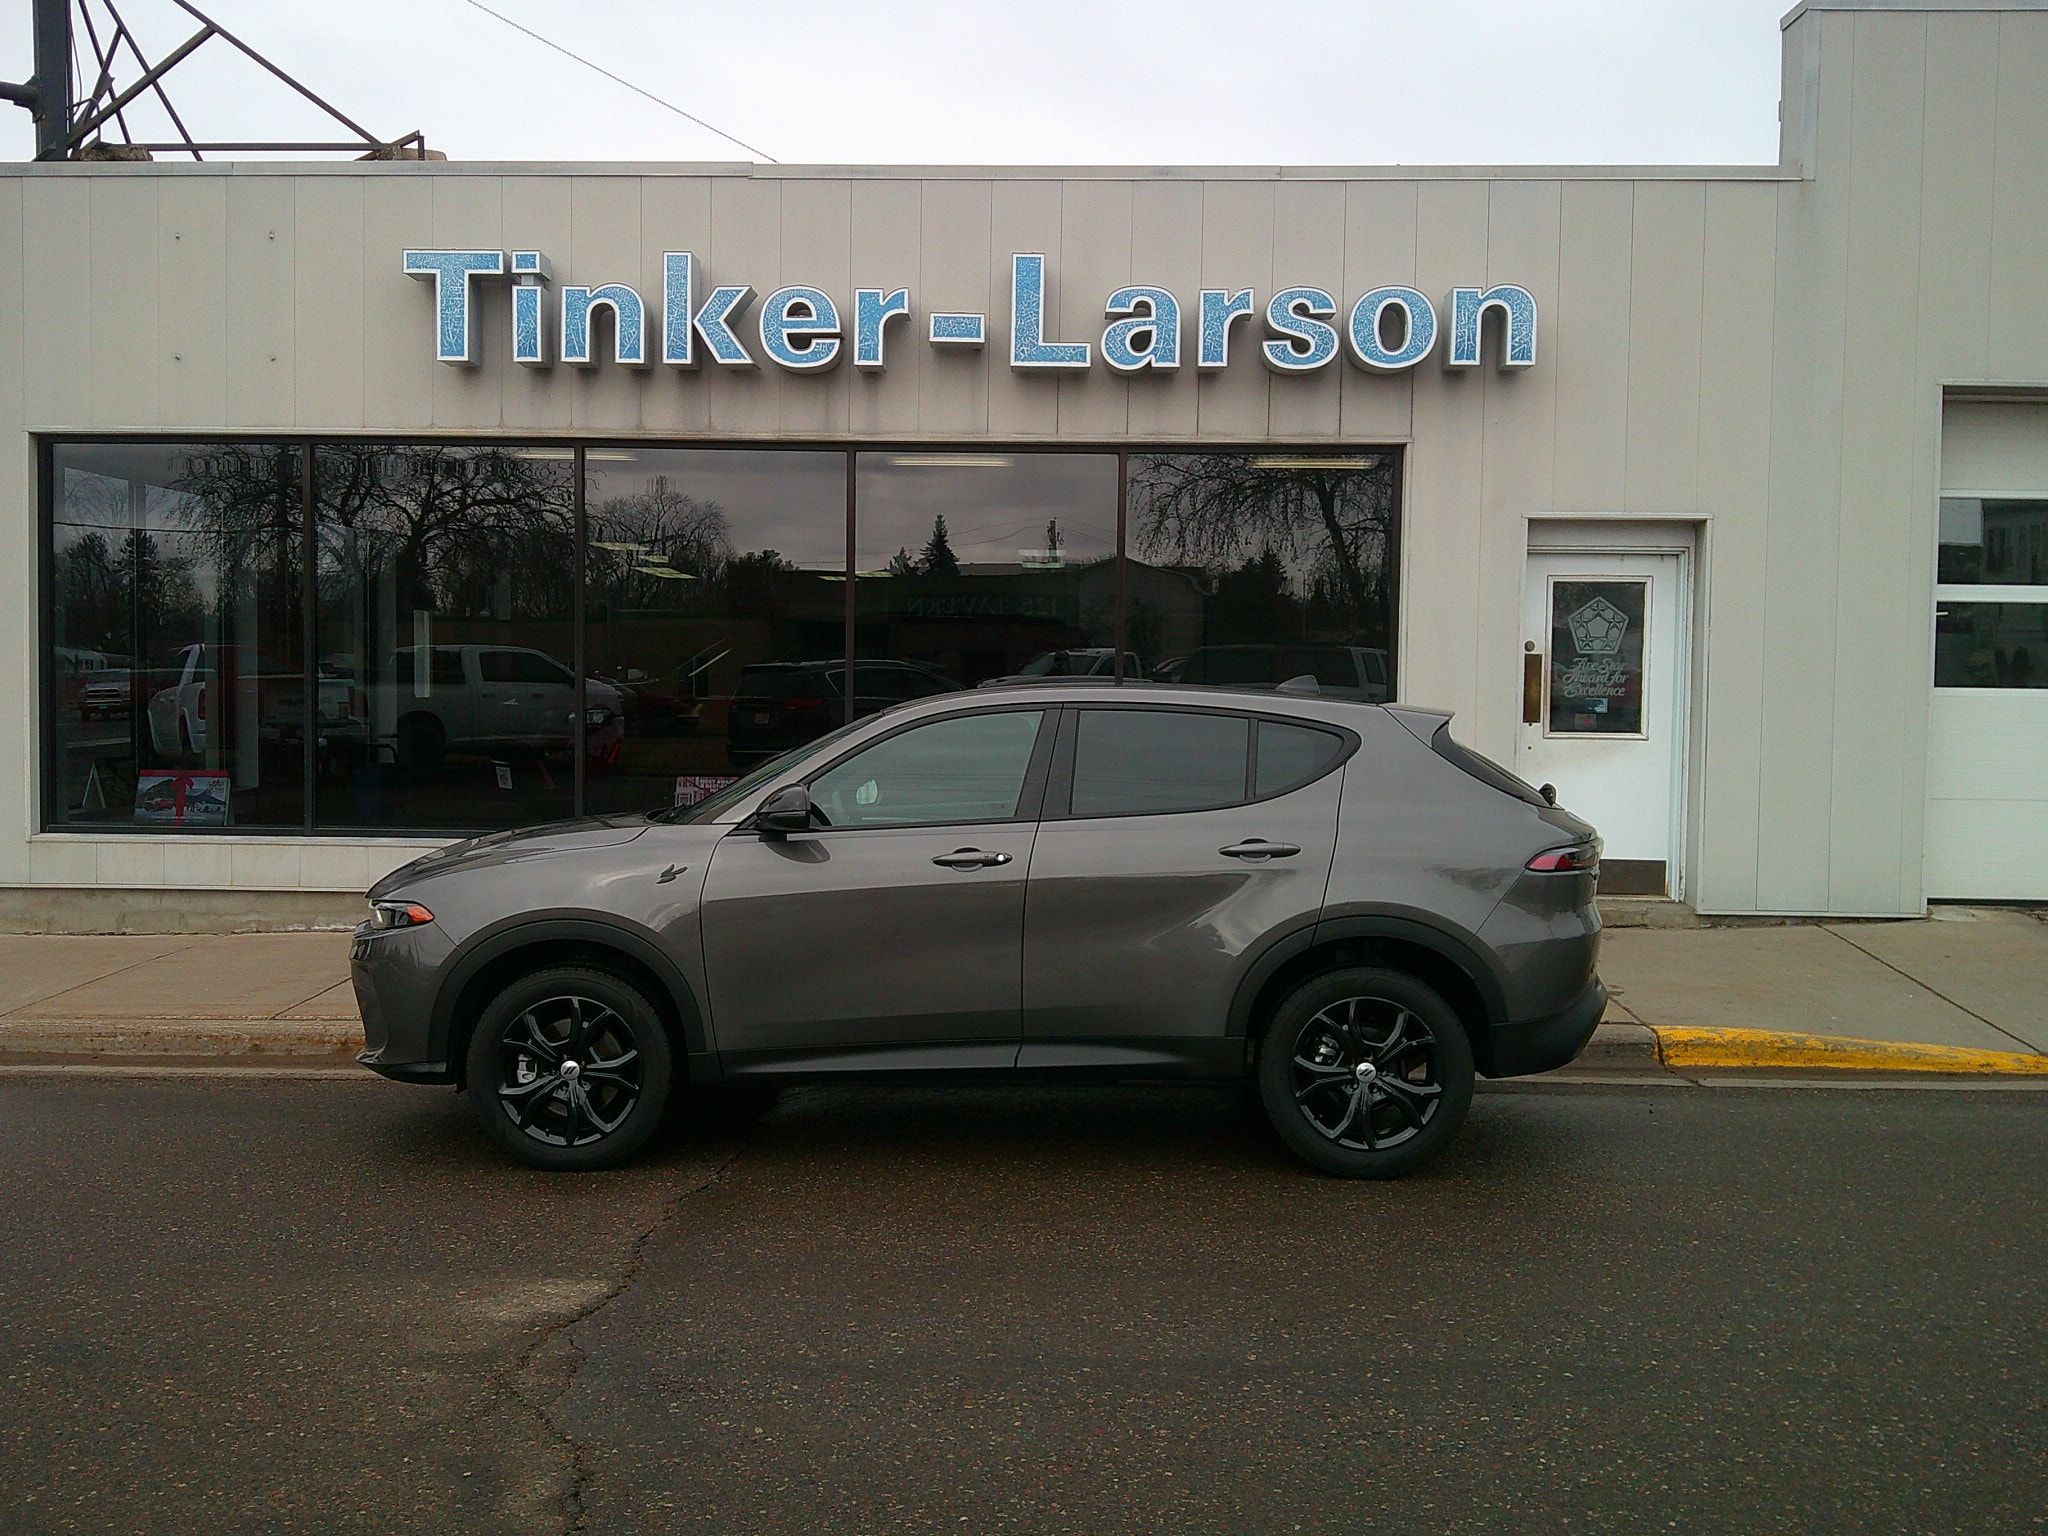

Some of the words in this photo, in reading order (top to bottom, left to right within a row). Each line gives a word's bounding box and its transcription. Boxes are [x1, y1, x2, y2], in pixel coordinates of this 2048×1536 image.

[403, 249, 1539, 371] Tinker-Larson
[1572, 657, 1599, 671] Five
[1597, 658, 1626, 673] Star
[1562, 671, 1610, 684] Award
[1607, 671, 1629, 686] for
[1563, 683, 1626, 698] Excellence
